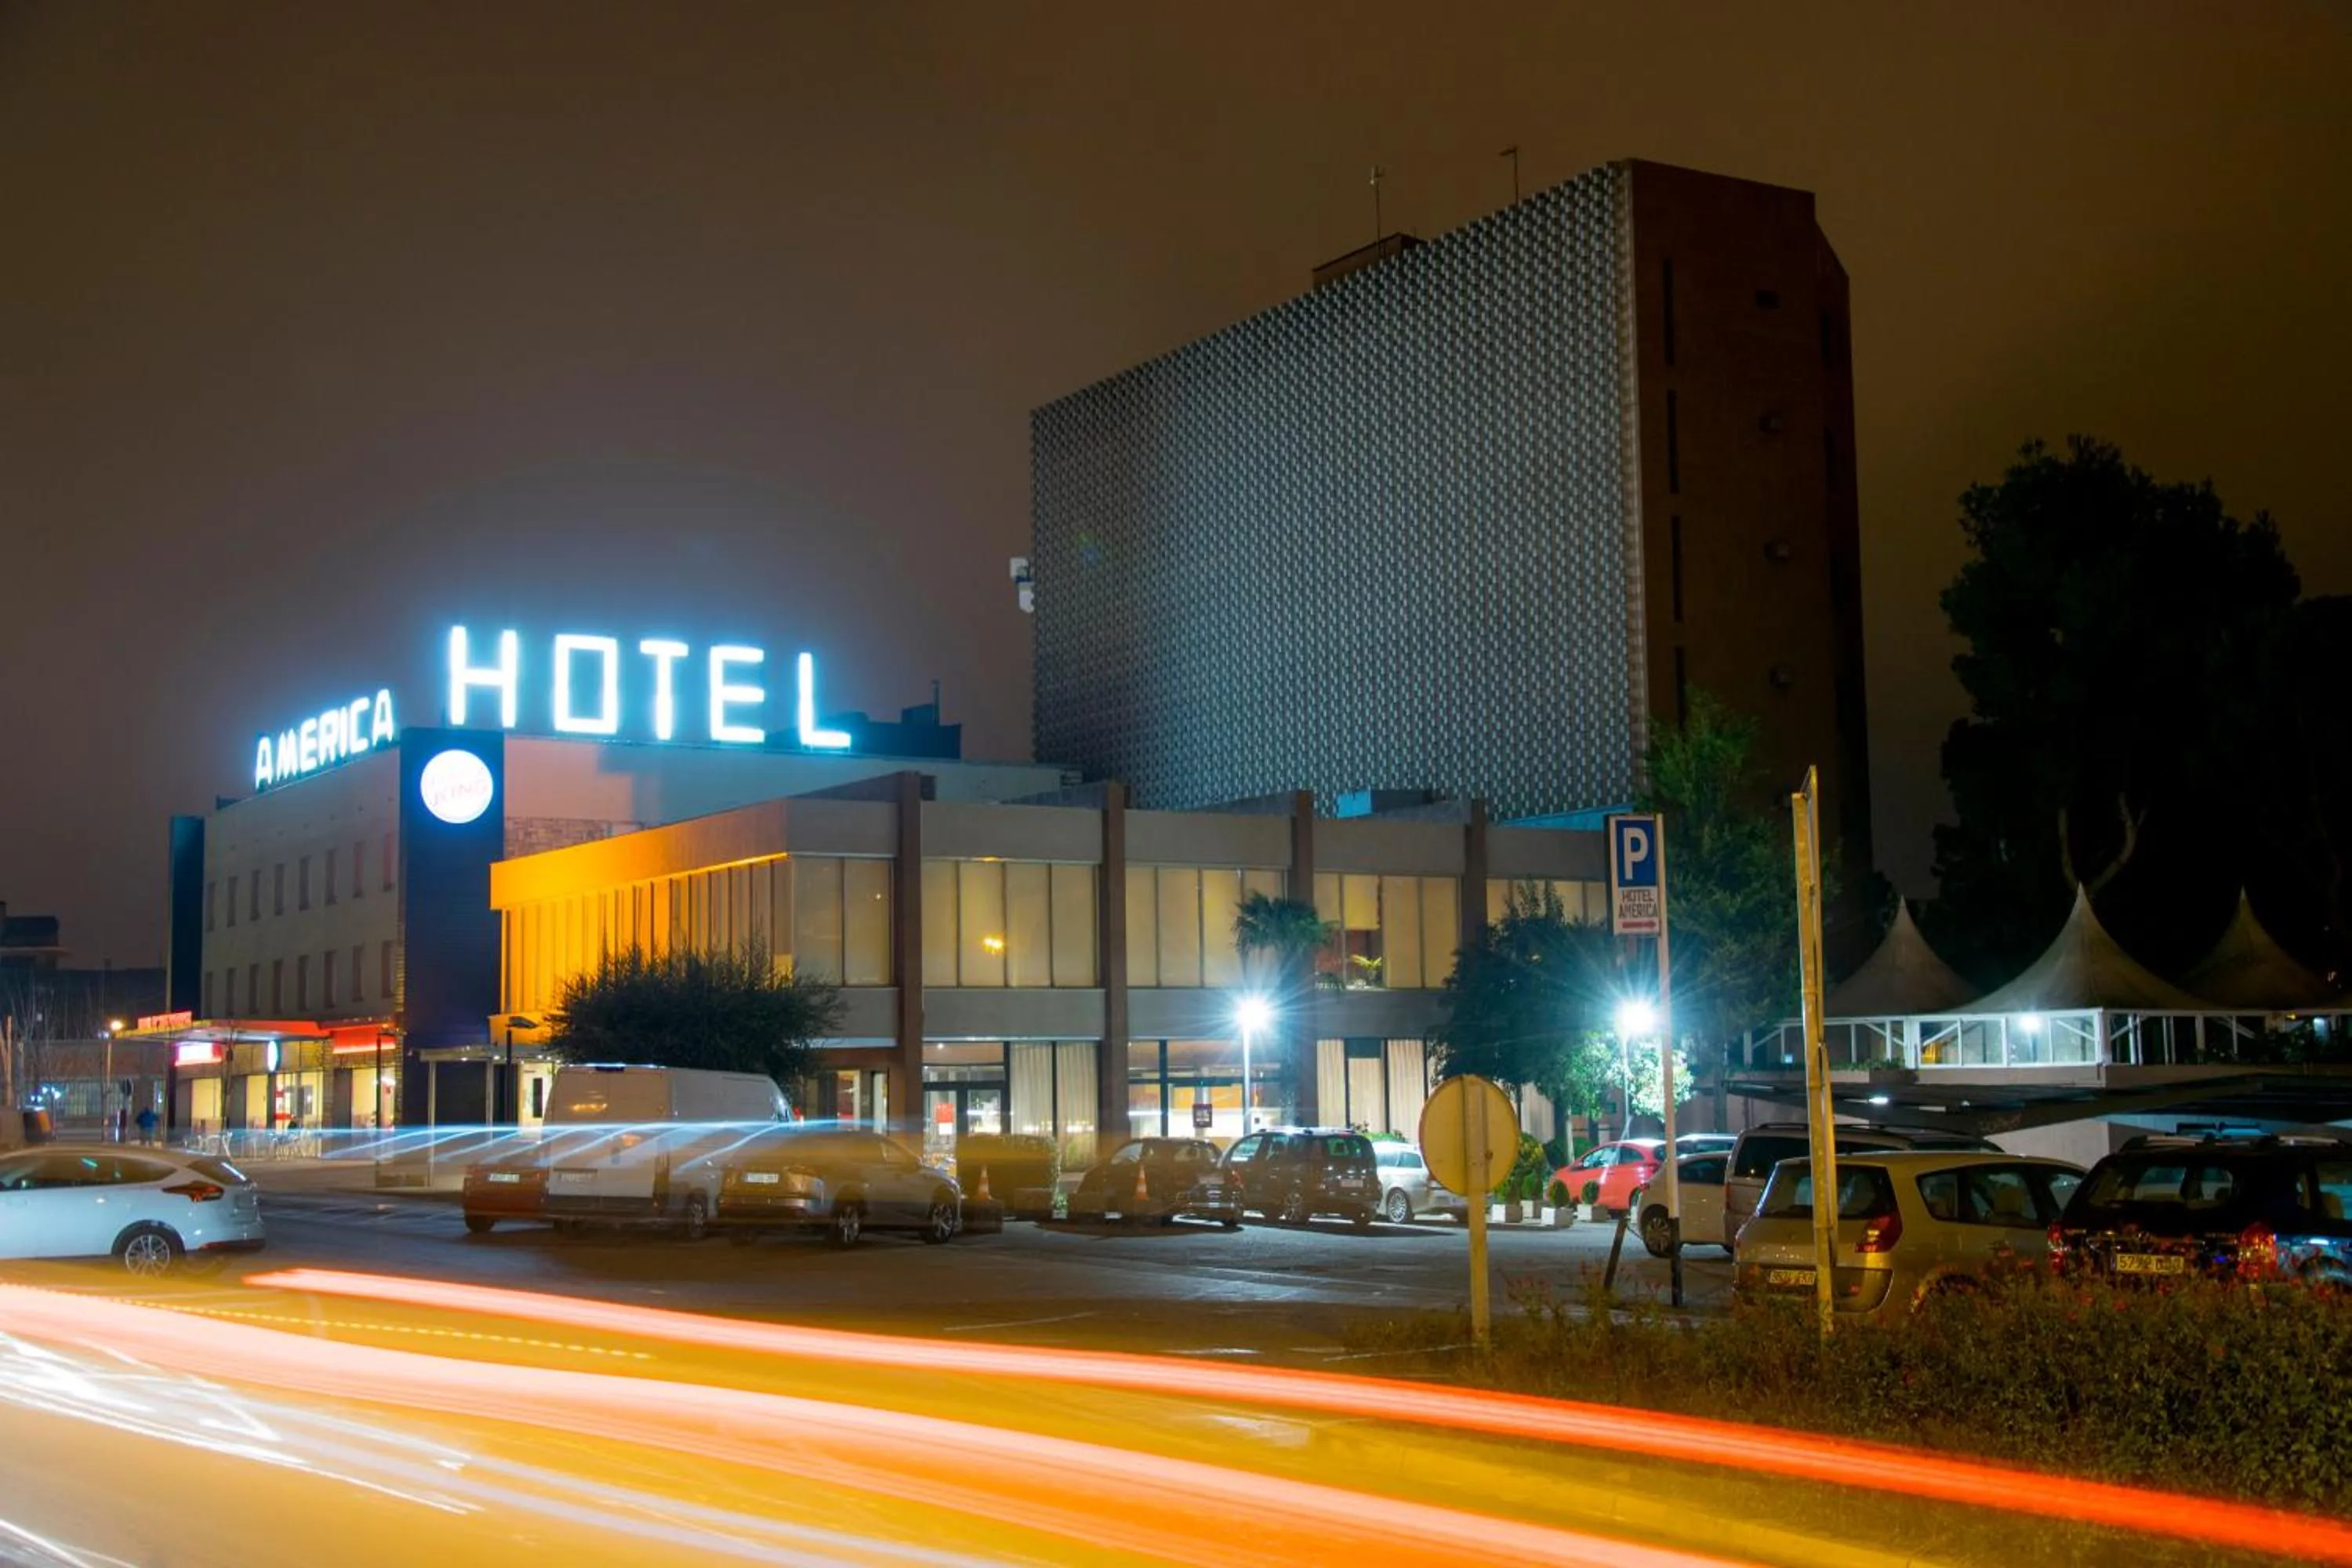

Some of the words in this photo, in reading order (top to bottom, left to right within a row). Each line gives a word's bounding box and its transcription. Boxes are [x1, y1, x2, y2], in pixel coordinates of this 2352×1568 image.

[449, 625, 852, 748] HOTEL
[255, 687, 394, 791] AMERICA
[1623, 827, 1649, 880] P
[1618, 902, 1658, 919] AMERICA
[1622, 889, 1654, 902] HOTEL
